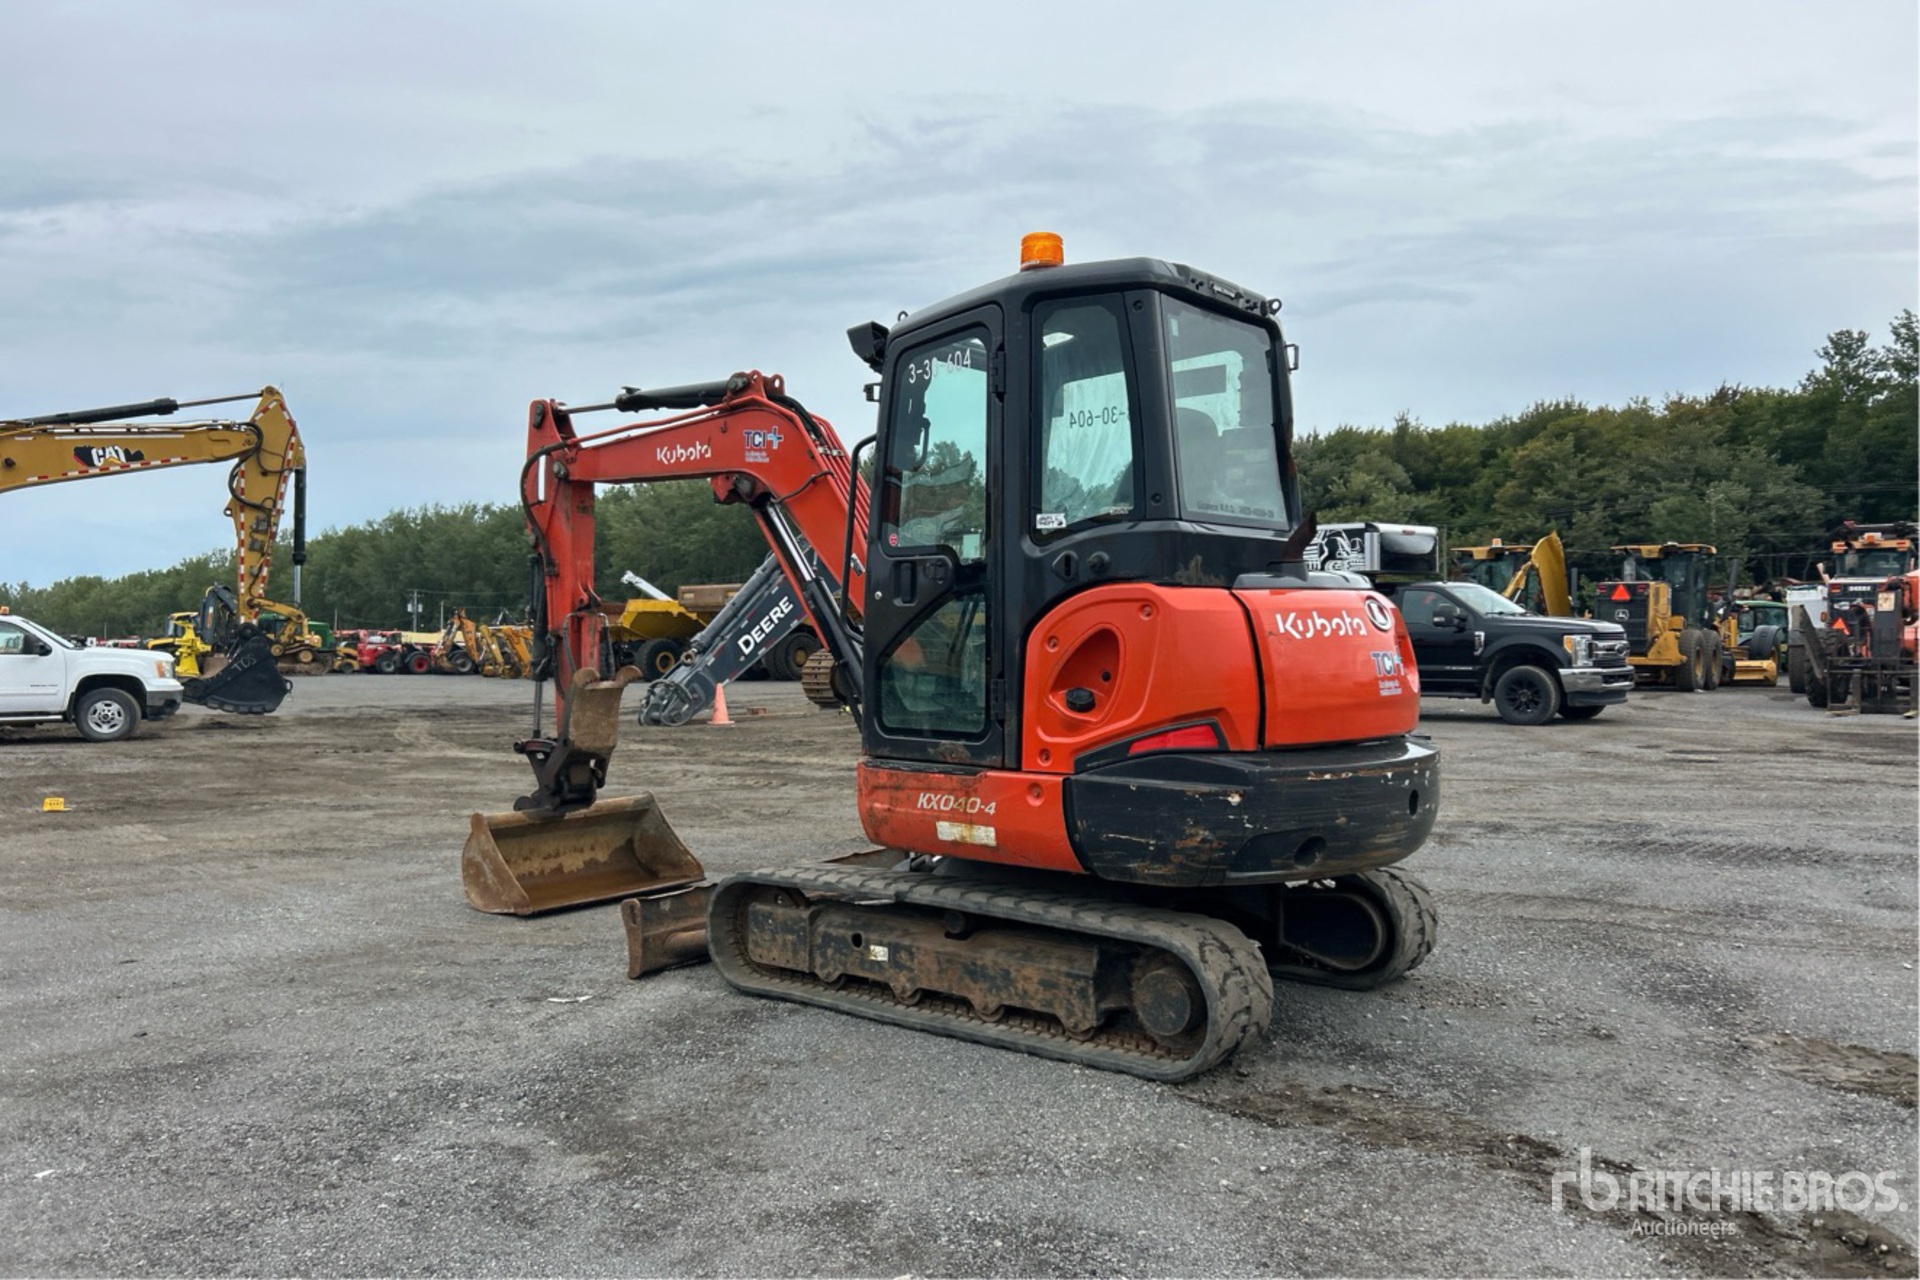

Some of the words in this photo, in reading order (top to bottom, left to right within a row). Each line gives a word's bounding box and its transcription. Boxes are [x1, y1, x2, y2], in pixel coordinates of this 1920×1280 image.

[908, 347, 972, 385] 3-30-604
[90, 445, 127, 467] CAT
[656, 440, 712, 465] Kubota
[737, 595, 794, 655] DEERE
[1275, 610, 1368, 640] Kubota
[917, 792, 997, 816] KX040-4
